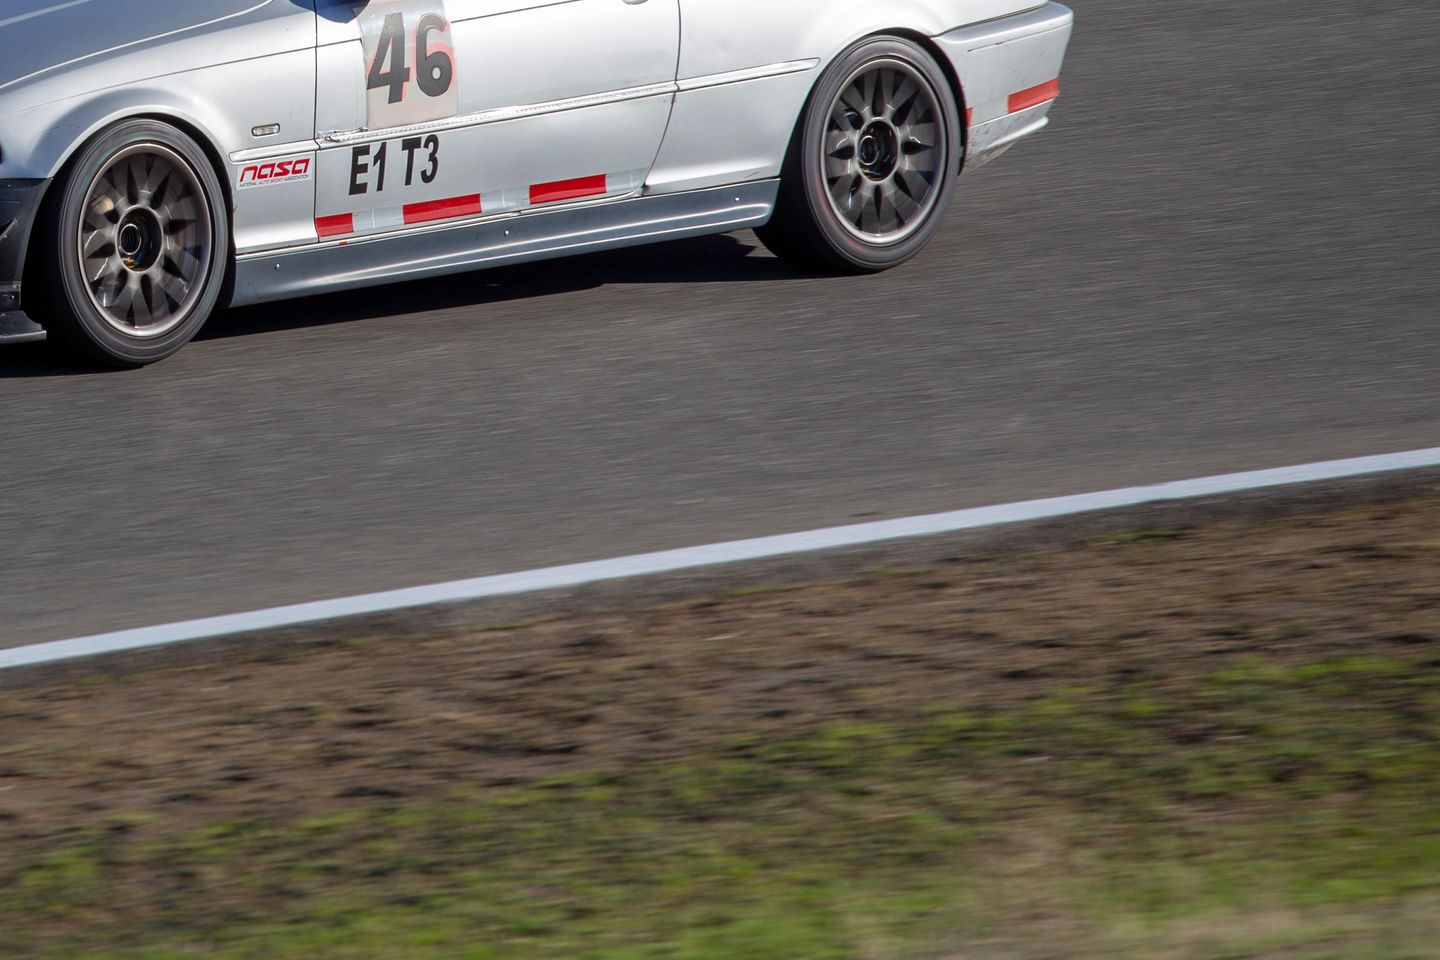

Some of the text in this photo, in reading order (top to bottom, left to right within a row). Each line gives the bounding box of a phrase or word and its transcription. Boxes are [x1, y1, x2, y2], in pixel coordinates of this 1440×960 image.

[366, 12, 453, 104] 46
[348, 134, 440, 196] E1 T3
